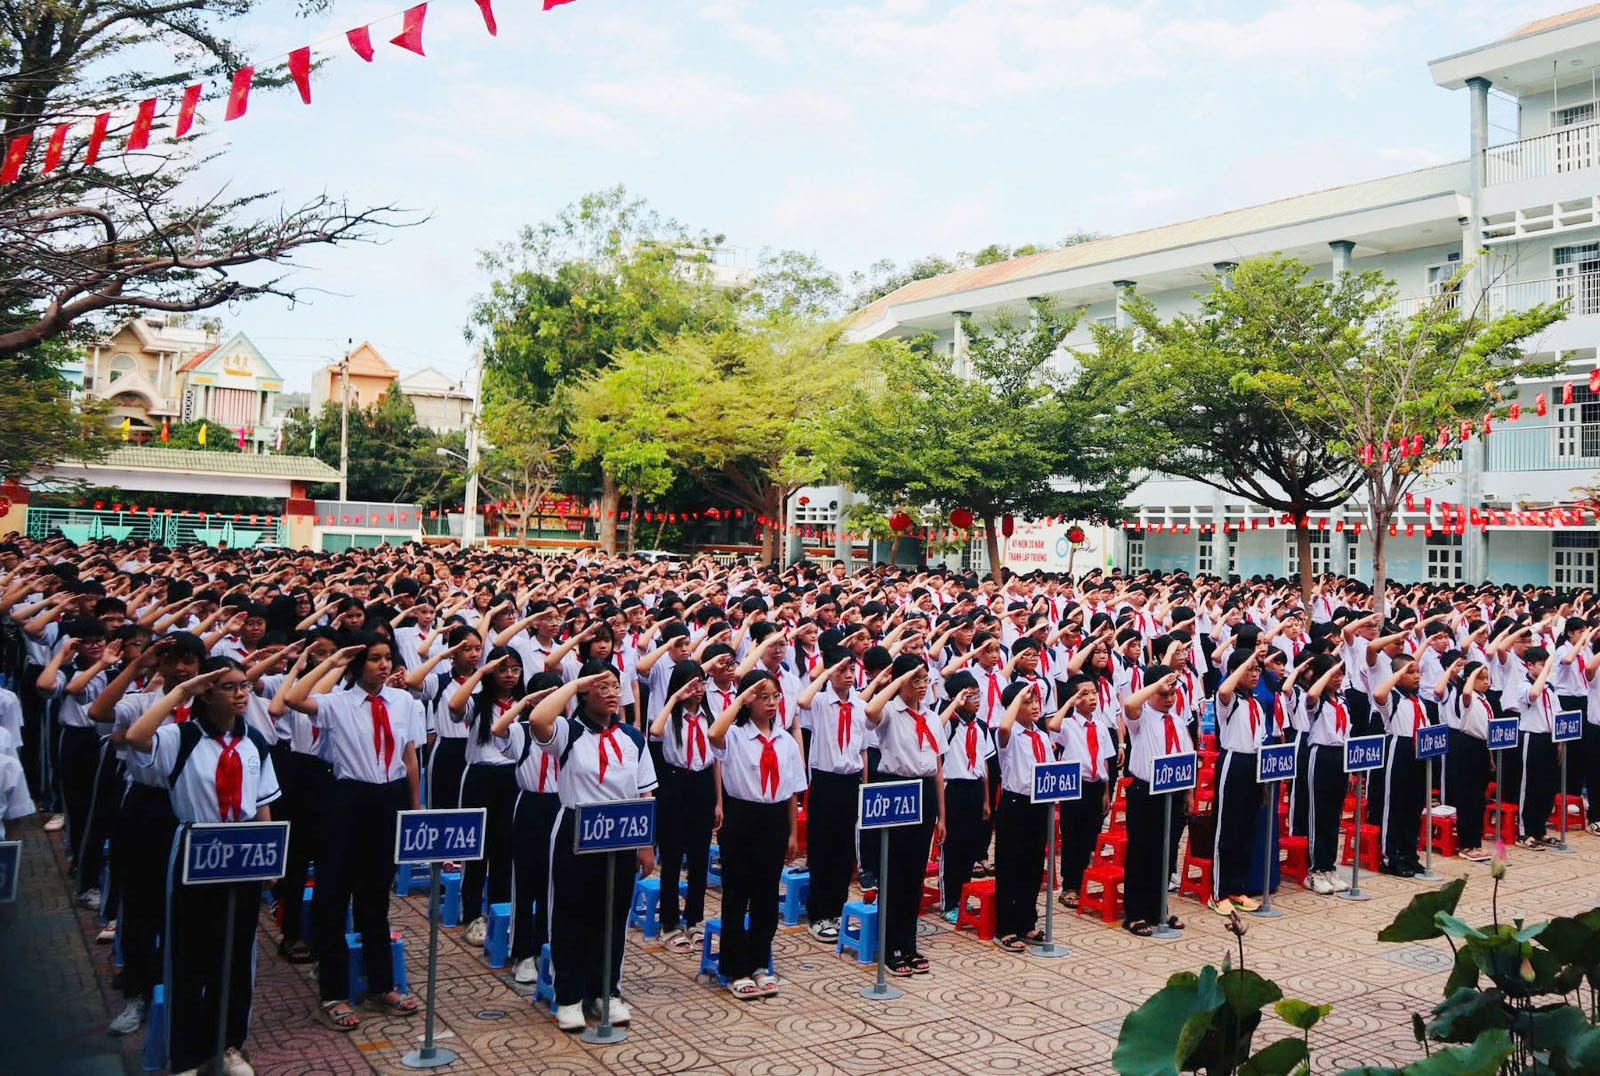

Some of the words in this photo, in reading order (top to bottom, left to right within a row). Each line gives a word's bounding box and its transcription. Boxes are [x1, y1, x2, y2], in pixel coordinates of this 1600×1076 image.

[1421, 734, 1433, 752] LỚP
[1434, 734, 1446, 749] 6A5
[1262, 753, 1277, 773] LỚP
[1279, 755, 1293, 771] 6A3
[1349, 745, 1364, 764] LỚP
[1366, 747, 1380, 762] 6A4
[1037, 771, 1056, 793] LỚP
[1059, 773, 1076, 792] 6A1
[1155, 763, 1173, 785] LỚP
[1175, 764, 1192, 782] 6A2
[865, 792, 890, 818] LỚP
[894, 795, 916, 815] 7A1
[403, 821, 439, 851] LỚP
[444, 826, 476, 849] 7A4
[583, 812, 615, 841] LỚP
[619, 815, 648, 839] 7A3
[193, 837, 234, 870] LỚP
[240, 842, 278, 868] 7A5
